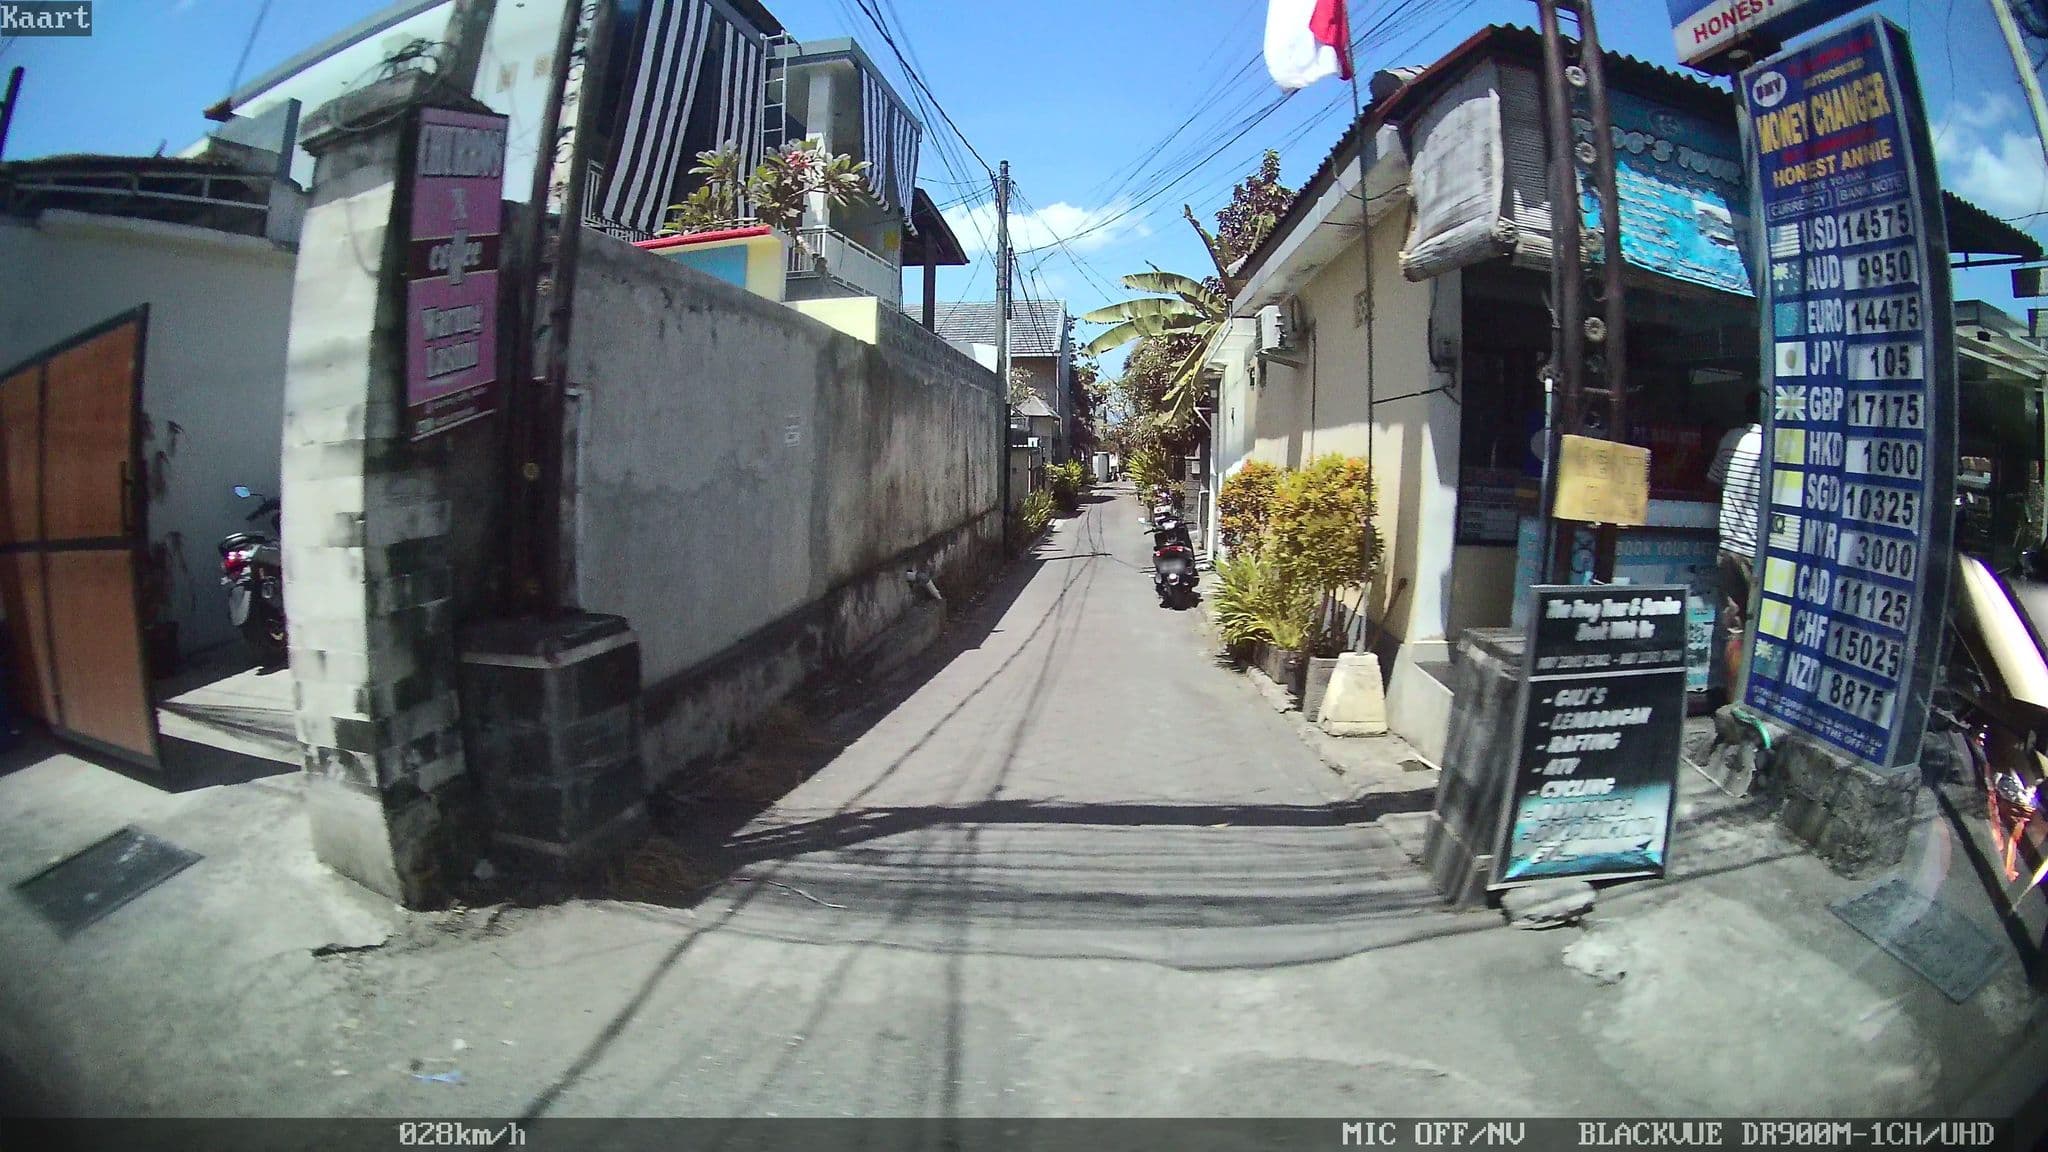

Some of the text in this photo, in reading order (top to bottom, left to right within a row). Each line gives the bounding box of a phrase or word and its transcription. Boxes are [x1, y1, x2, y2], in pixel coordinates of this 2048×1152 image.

[1756, 101, 1809, 154] MONEY
[1811, 72, 1891, 136] CHANGER
[1772, 155, 1836, 188] HONEST
[1841, 138, 1893, 170] ANNIE
[1802, 204, 1910, 251] USD 14575
[1806, 251, 1912, 291] AUD 9950
[1807, 296, 1919, 334] EURO 14475
[1810, 340, 1911, 377] JPY 105
[1809, 386, 1919, 427] GBP 17175
[1808, 431, 1918, 476] HKD 1600
[1806, 473, 1914, 526] SGD 10325
[1802, 518, 1912, 577] MYR 3000
[1798, 565, 1908, 627] CAD 11125
[1794, 610, 1899, 677] CHF 15025
[1785, 652, 1821, 692] NZD
